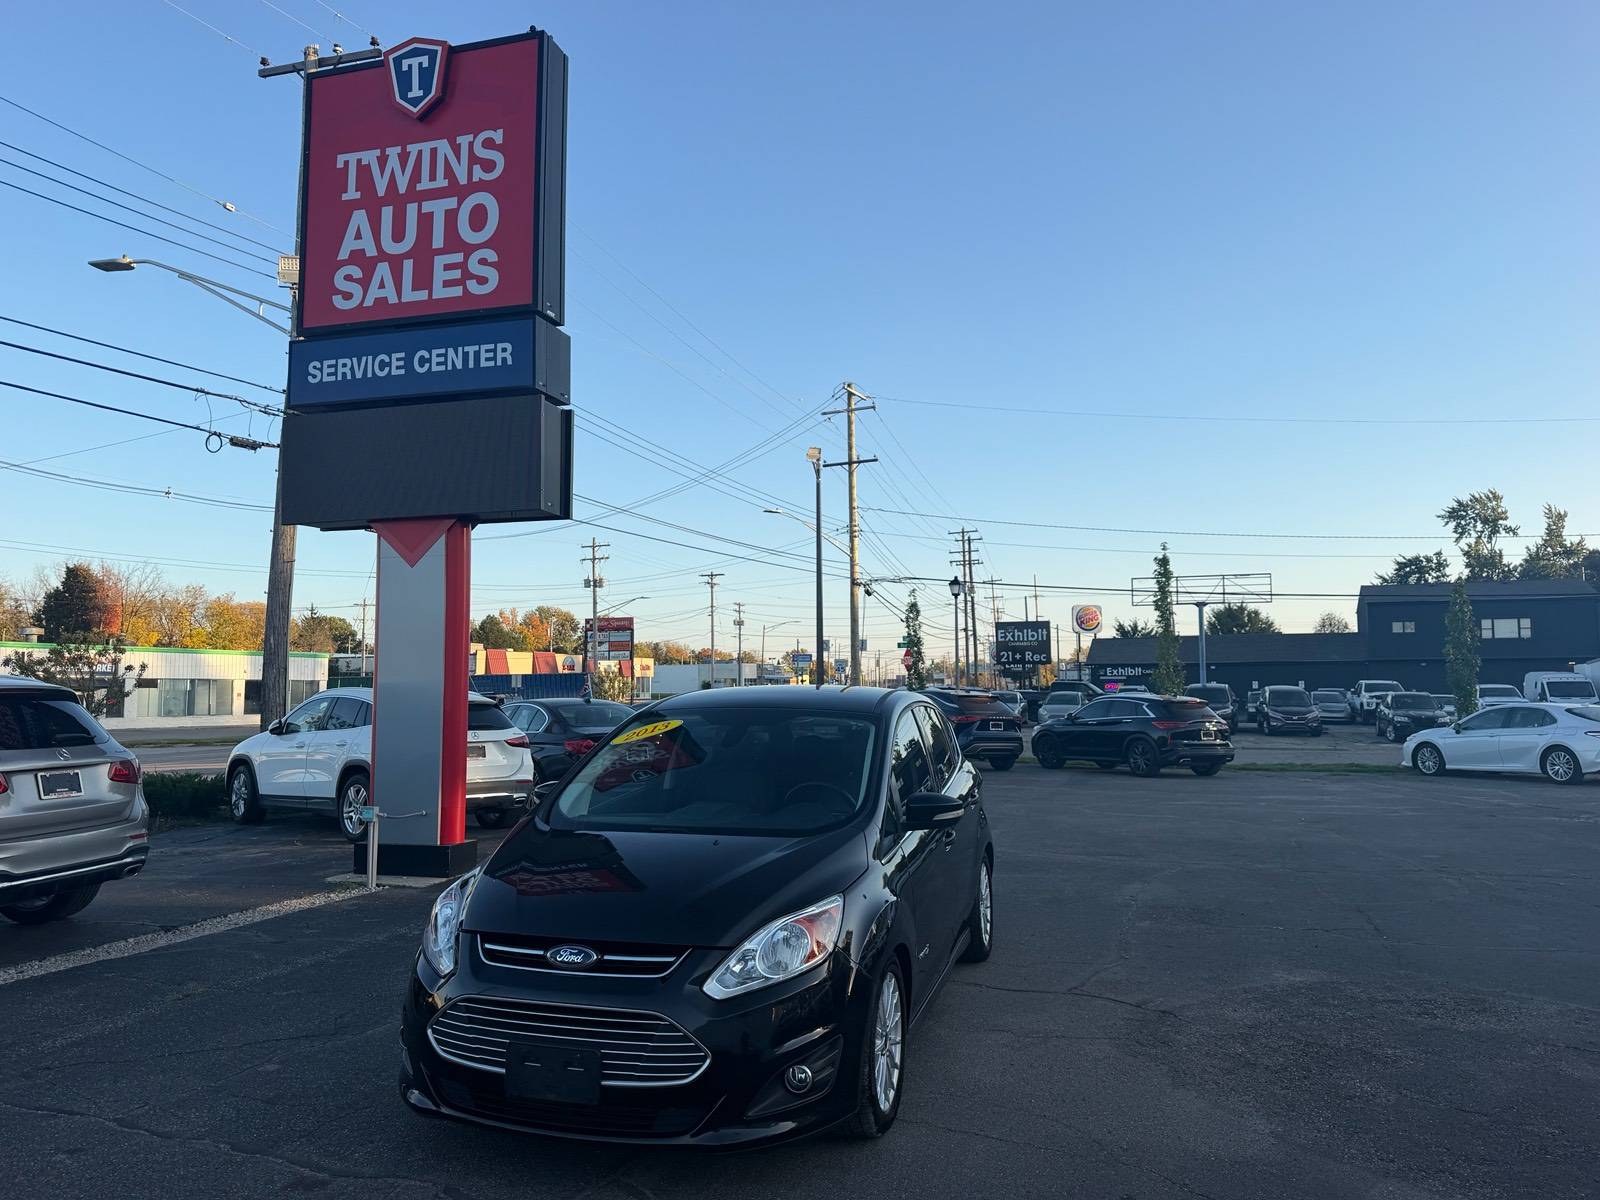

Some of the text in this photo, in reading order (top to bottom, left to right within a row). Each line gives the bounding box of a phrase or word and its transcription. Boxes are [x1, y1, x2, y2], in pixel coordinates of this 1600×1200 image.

[402, 55, 428, 99] T
[336, 129, 505, 200] TWINS
[336, 191, 500, 261] AUTO
[331, 248, 500, 311] SALES
[307, 342, 513, 384] SERVICE CENTER
[1080, 614, 1099, 625] KING
[1025, 651, 1047, 662] Rec
[623, 722, 672, 741] 2013
[556, 948, 585, 963] Ford
